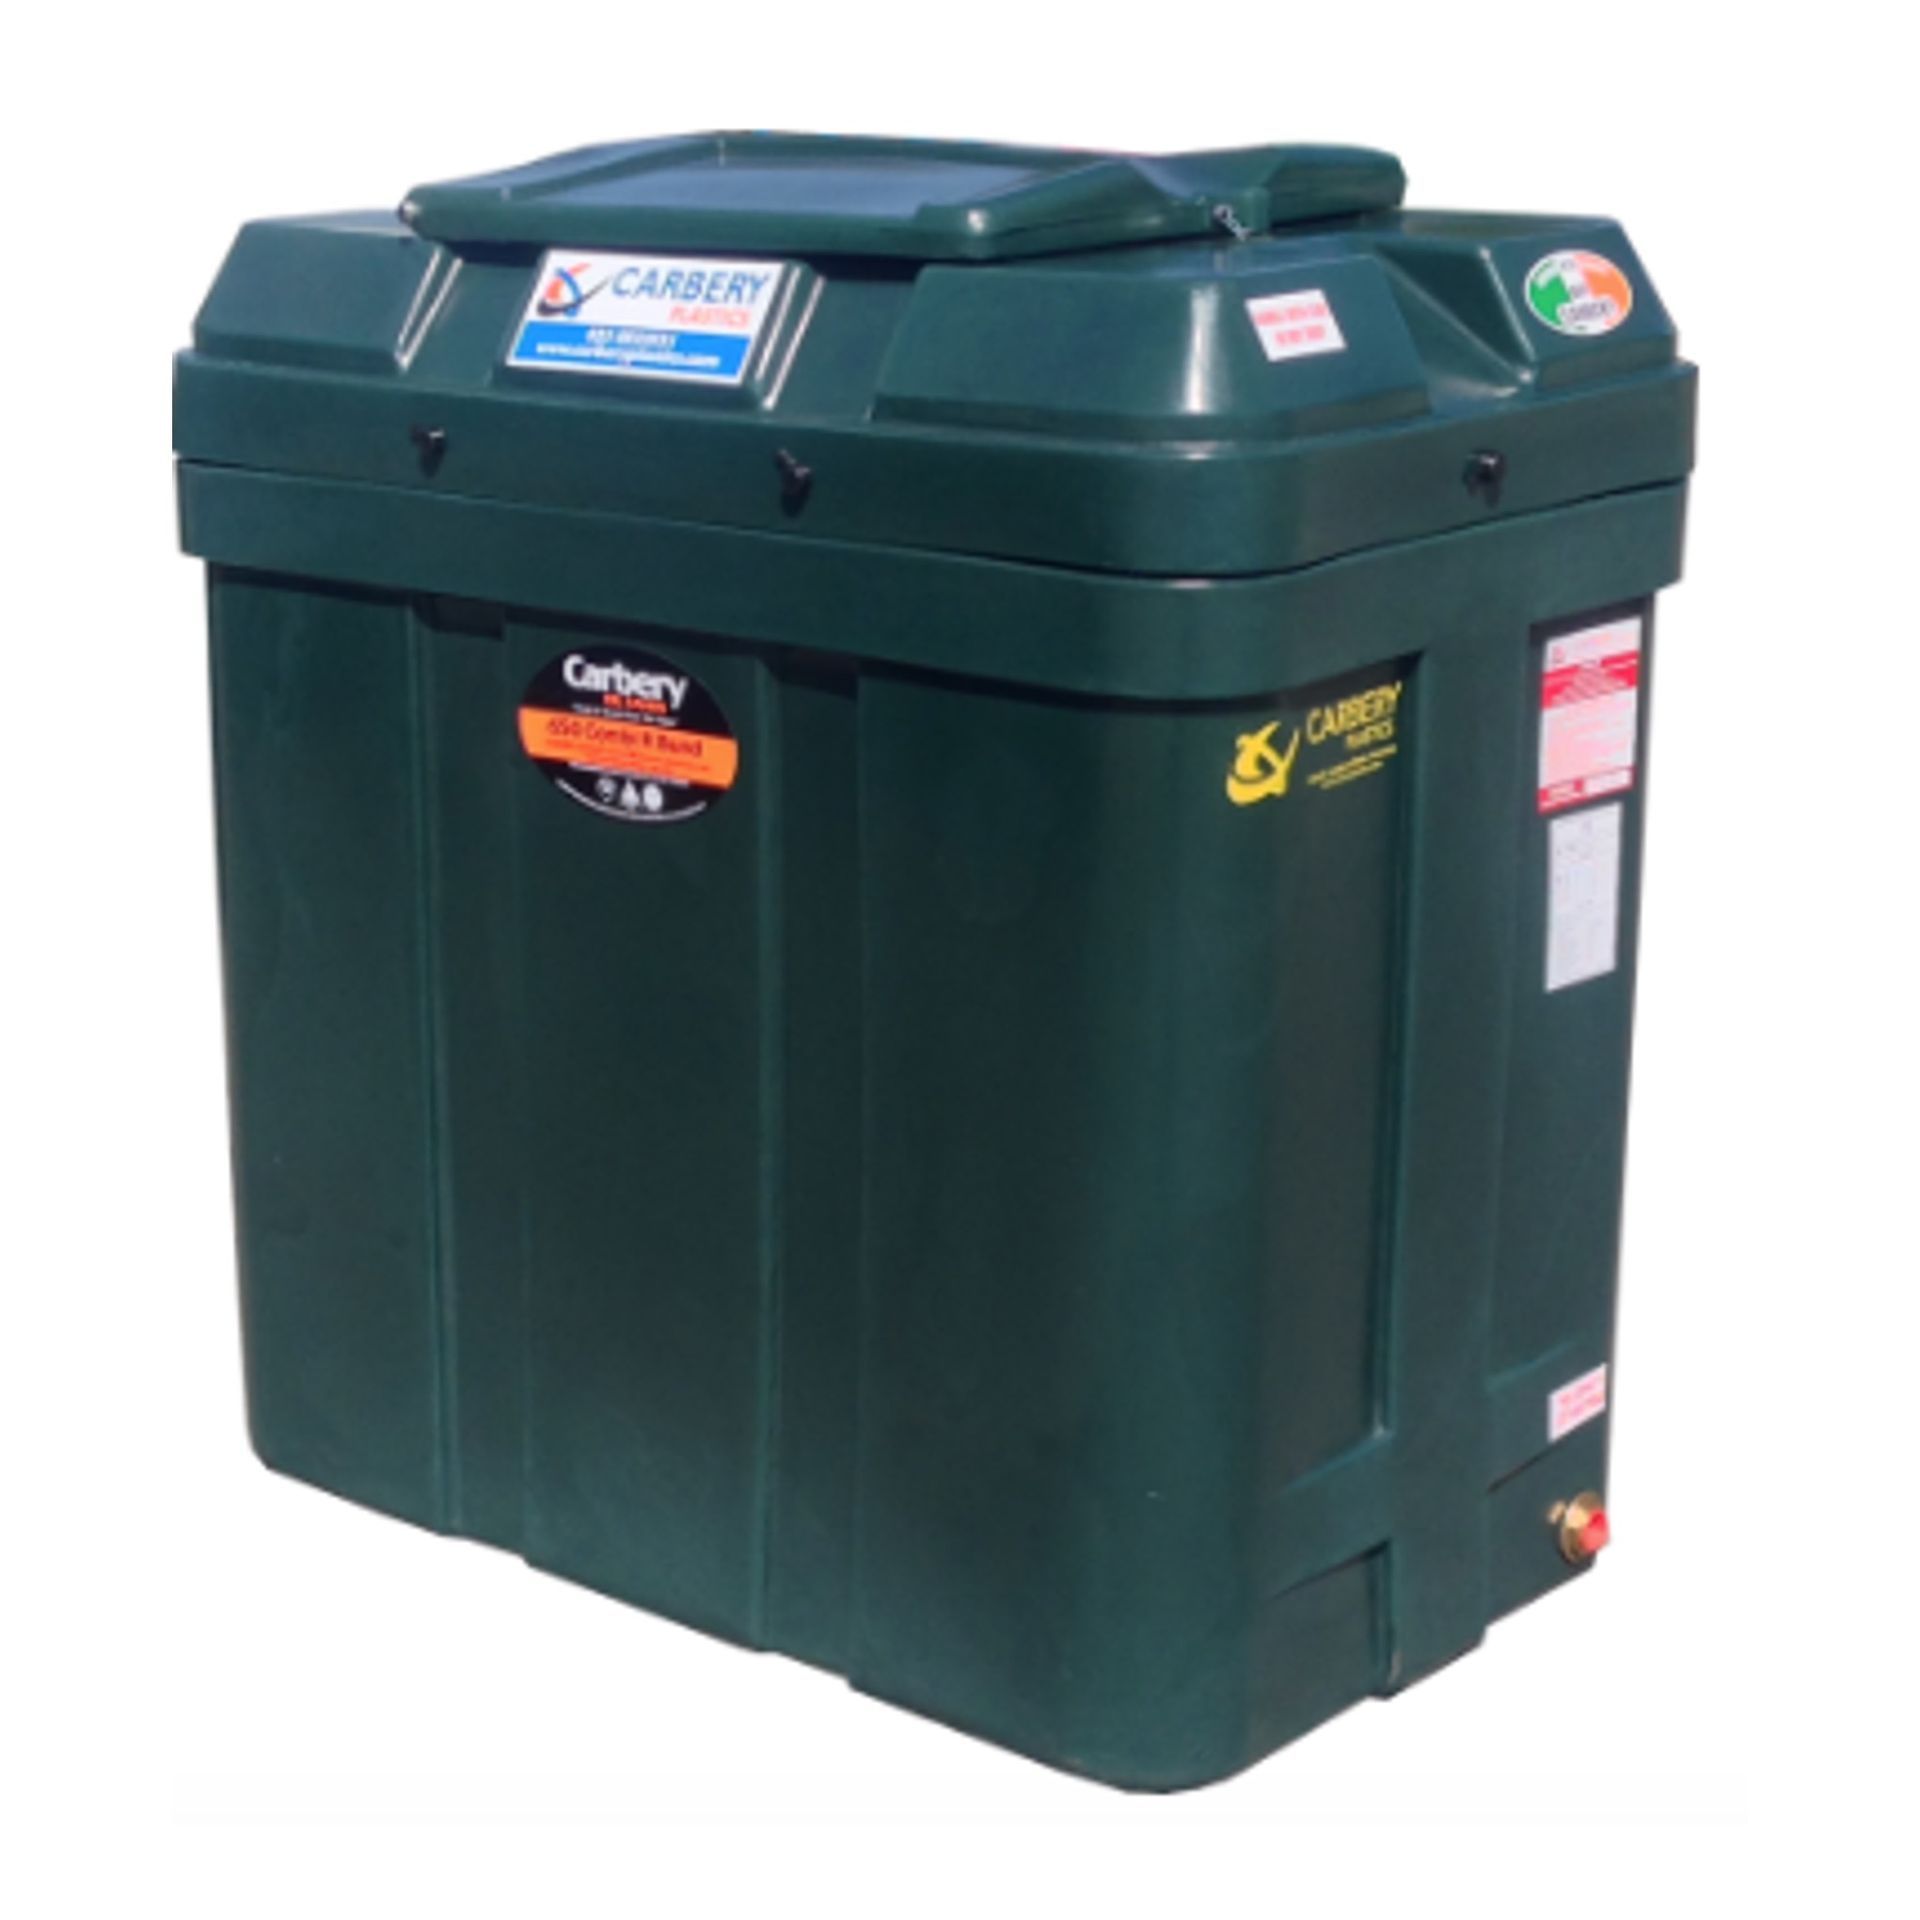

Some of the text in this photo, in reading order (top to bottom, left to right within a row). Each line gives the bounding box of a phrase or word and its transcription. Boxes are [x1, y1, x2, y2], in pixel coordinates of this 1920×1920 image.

[610, 265, 770, 305] CARBERY
[668, 305, 752, 330] PLASTICS
[562, 653, 689, 711] Carbery
[1306, 680, 1402, 745] CARBERY
